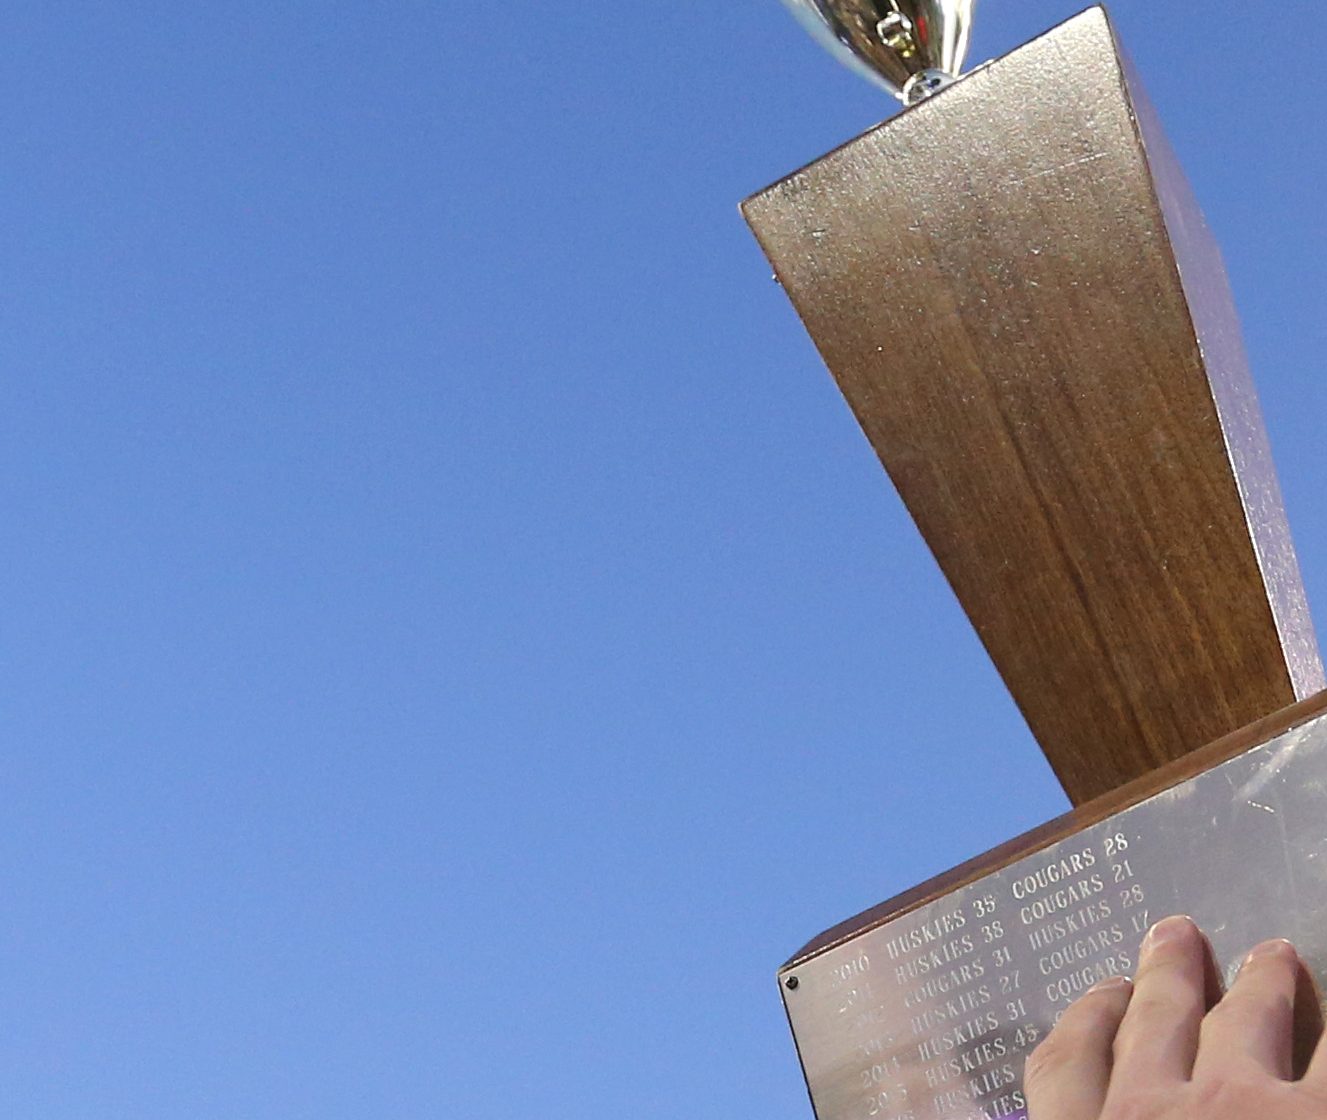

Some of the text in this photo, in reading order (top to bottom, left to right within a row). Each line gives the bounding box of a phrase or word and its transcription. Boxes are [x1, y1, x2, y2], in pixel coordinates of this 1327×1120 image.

[886, 909, 966, 960] HUSKIES
[972, 894, 997, 918] 35
[1012, 848, 1096, 899] COUGARS
[1104, 832, 1128, 857] 28
[895, 934, 974, 985] HUSKIES
[981, 920, 1004, 943] 38
[1021, 873, 1104, 925] COUGARS
[1112, 859, 1134, 883] 21
[903, 884, 1144, 1008] COUGARS 31 HUSKIES 28
[910, 984, 991, 1035] HUSKIES
[999, 970, 1021, 994] 27
[1039, 923, 1123, 975] COUGARS
[1131, 909, 1151, 933] 17
[918, 1011, 999, 1062] HUSKIES
[1006, 998, 1026, 1021] 31
[1047, 951, 1131, 1002] COUGARS
[925, 1037, 1007, 1088] HUSKIES
[1015, 1023, 1038, 1047] 45
[933, 1063, 1016, 1114] HUSKIES
